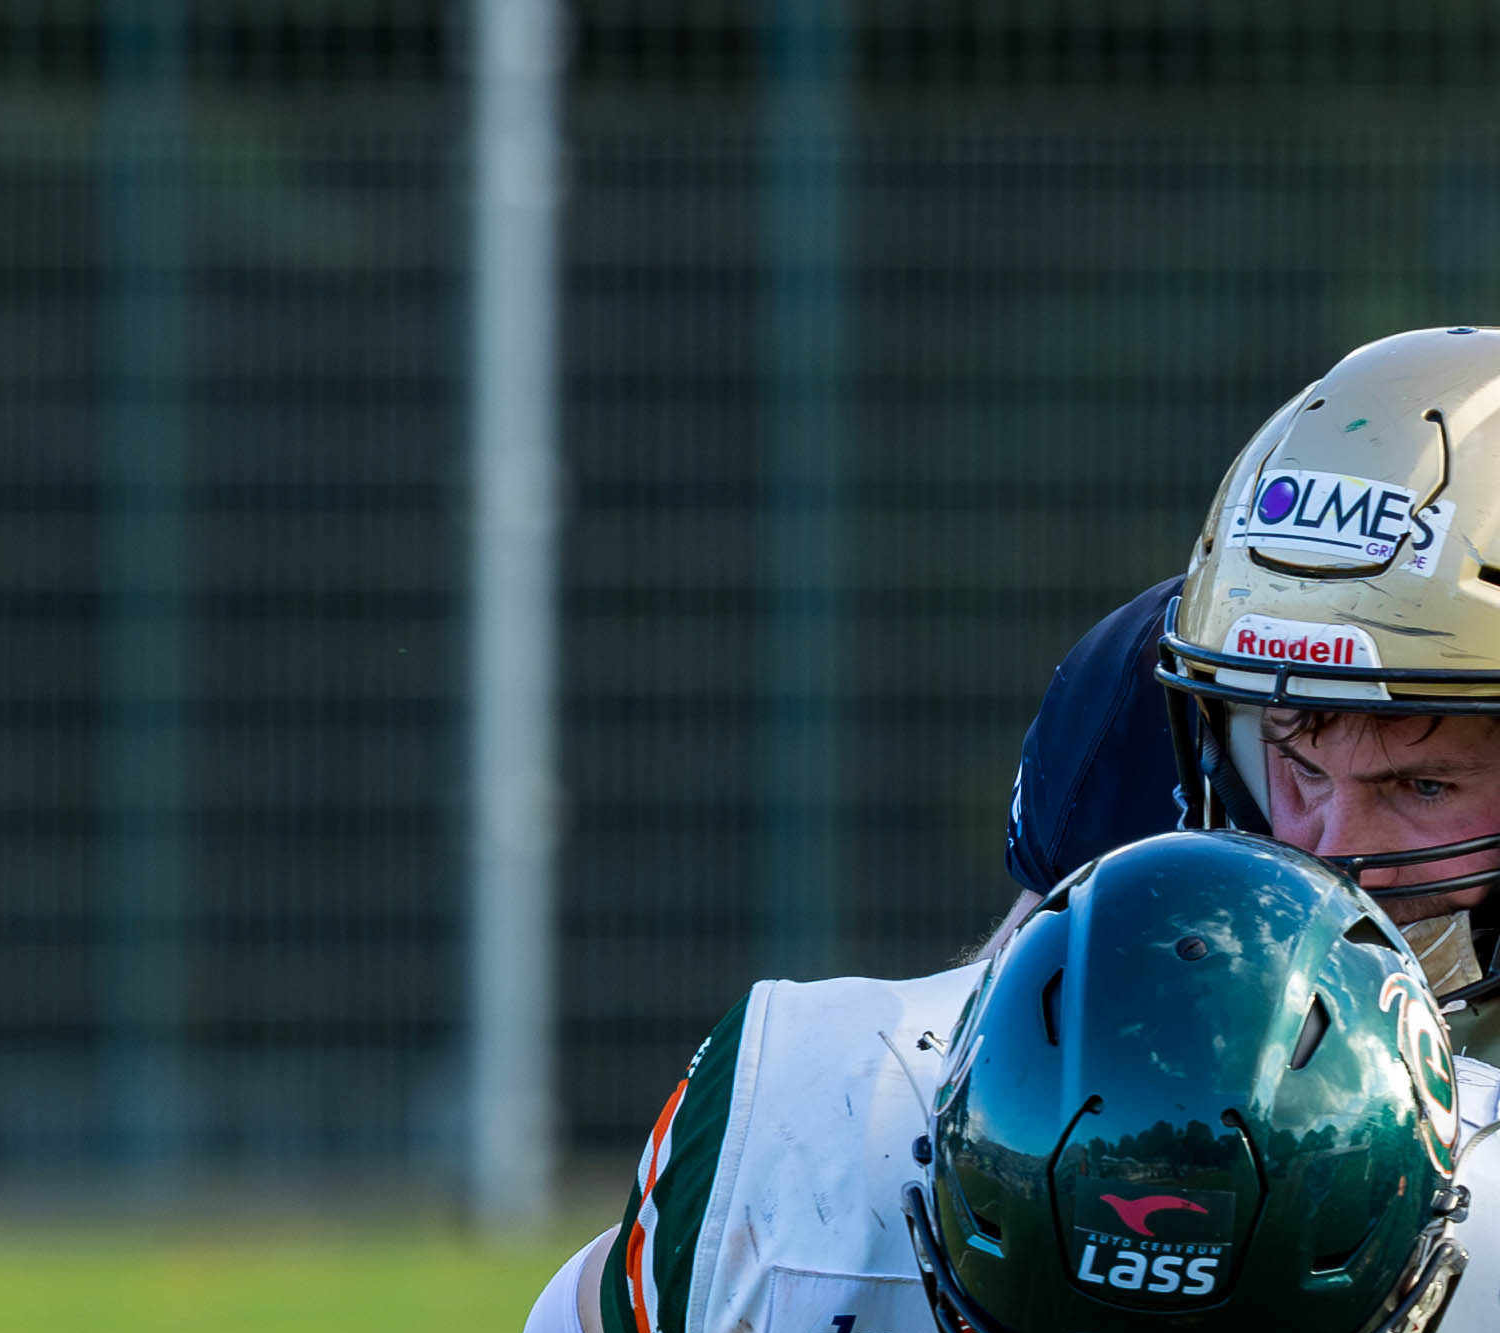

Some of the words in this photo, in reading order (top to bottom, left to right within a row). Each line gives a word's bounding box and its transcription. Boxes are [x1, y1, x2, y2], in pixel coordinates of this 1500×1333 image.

[1237, 629, 1354, 665] Riddell
[1088, 1232, 1132, 1248] AUTO
[1140, 1240, 1223, 1256] CENTRUM
[1077, 1244, 1219, 1296] Lass
